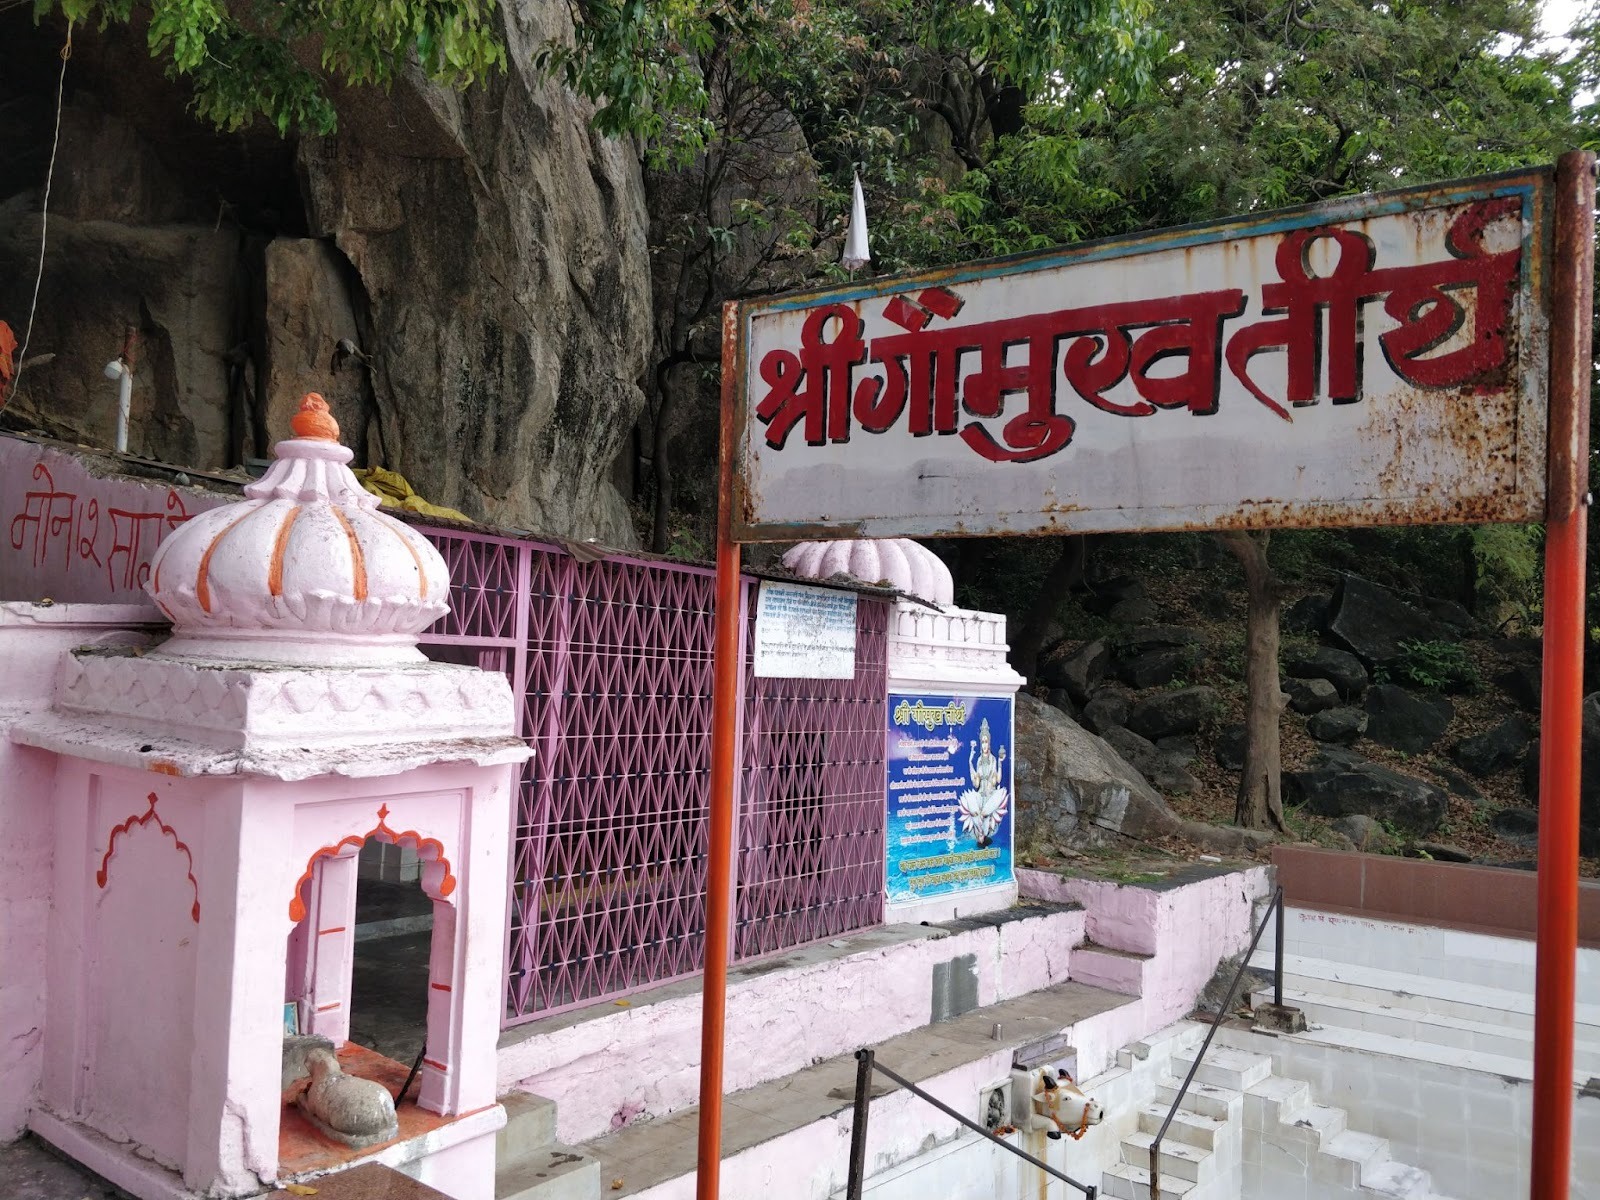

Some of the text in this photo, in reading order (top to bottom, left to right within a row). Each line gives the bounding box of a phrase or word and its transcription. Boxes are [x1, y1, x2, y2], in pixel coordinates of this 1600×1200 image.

[756, 303, 868, 451] श्री
[1225, 197, 1522, 424] तीर्थ
[894, 700, 911, 725] श्री
